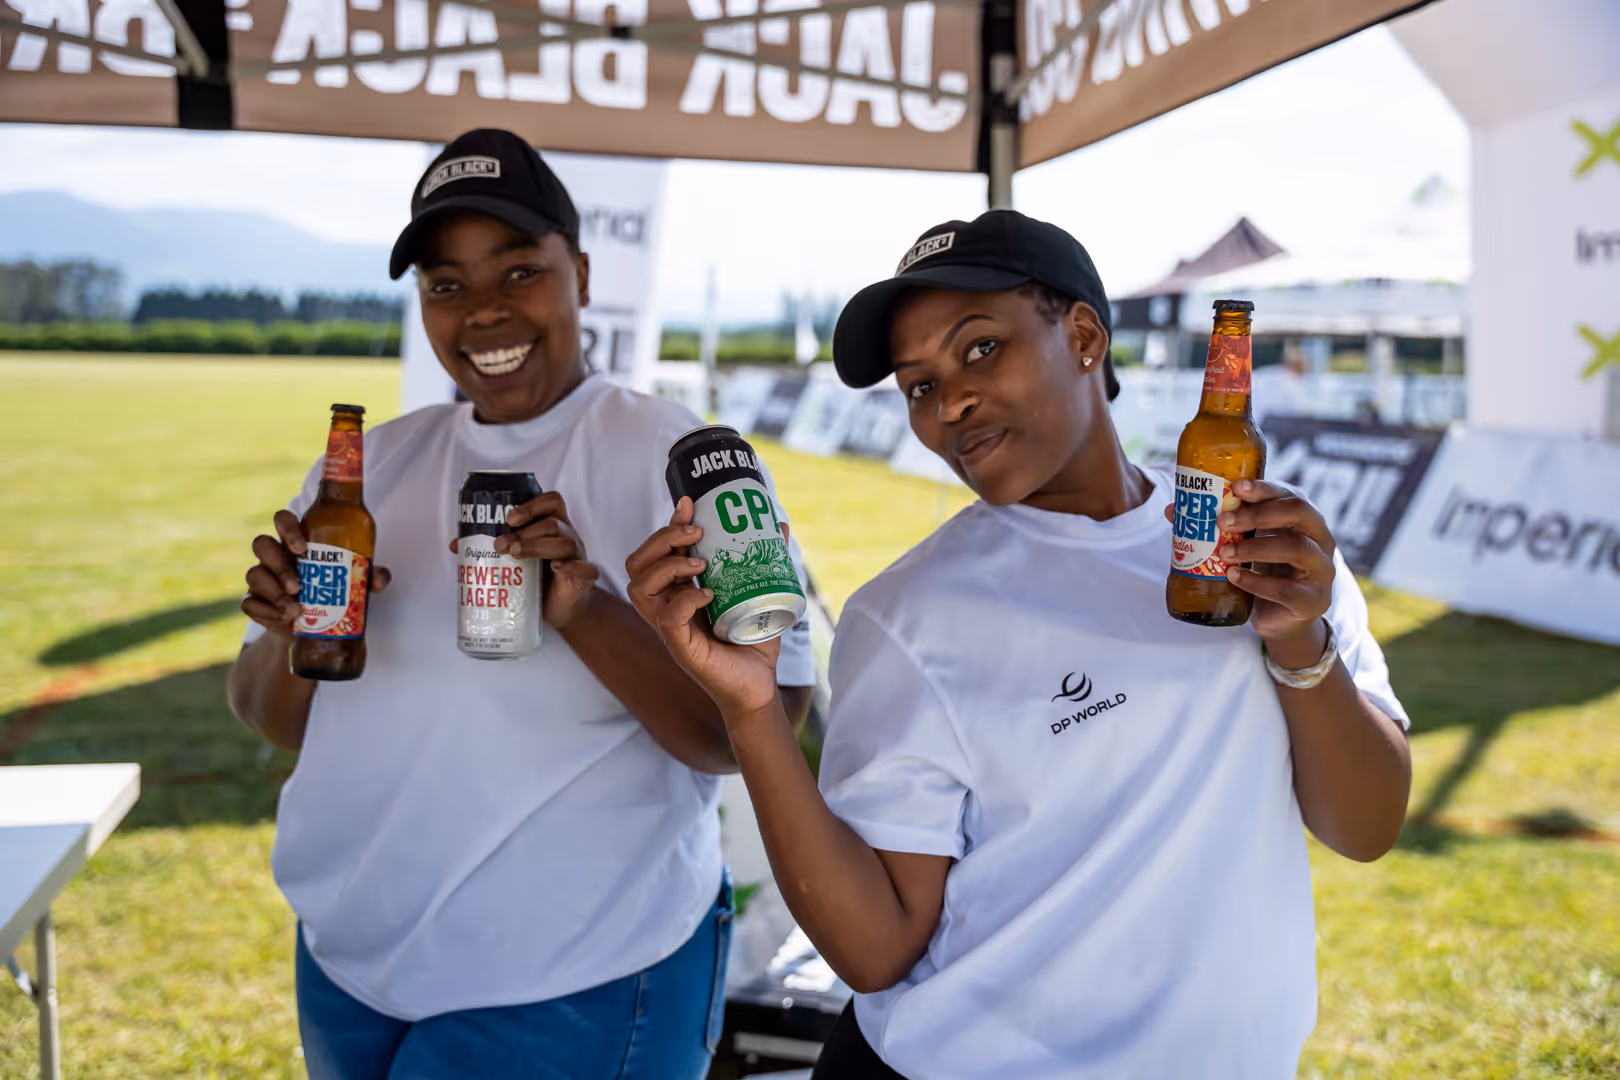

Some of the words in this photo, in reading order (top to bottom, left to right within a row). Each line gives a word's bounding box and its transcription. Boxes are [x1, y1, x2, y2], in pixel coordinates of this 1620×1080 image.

[691, 449, 736, 479] JACK
[460, 587, 509, 608] LAGER
[1050, 717, 1071, 735] DP
[1071, 692, 1126, 724] WORLD
